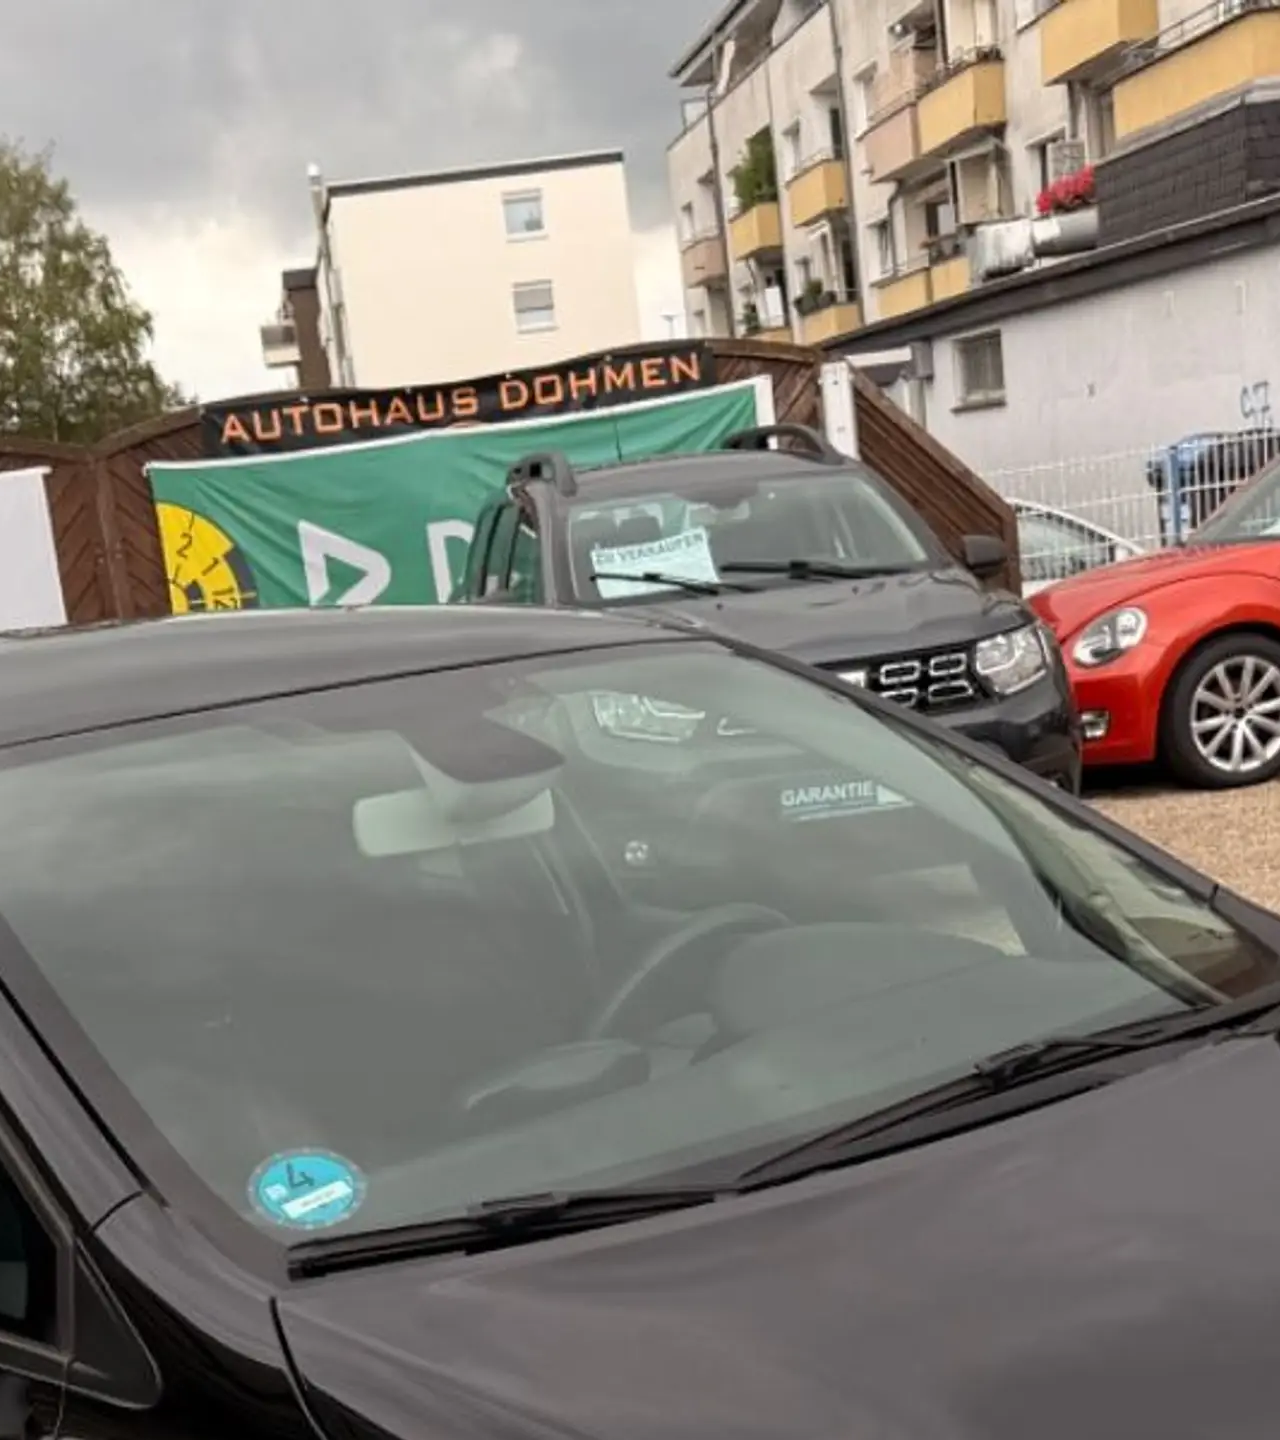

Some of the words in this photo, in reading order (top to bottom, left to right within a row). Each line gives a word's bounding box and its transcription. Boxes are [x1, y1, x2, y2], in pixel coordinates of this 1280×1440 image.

[221, 387, 479, 444] AUTOHAUS
[499, 352, 701, 411] DOHMEN
[781, 779, 874, 807] GARANTIE
